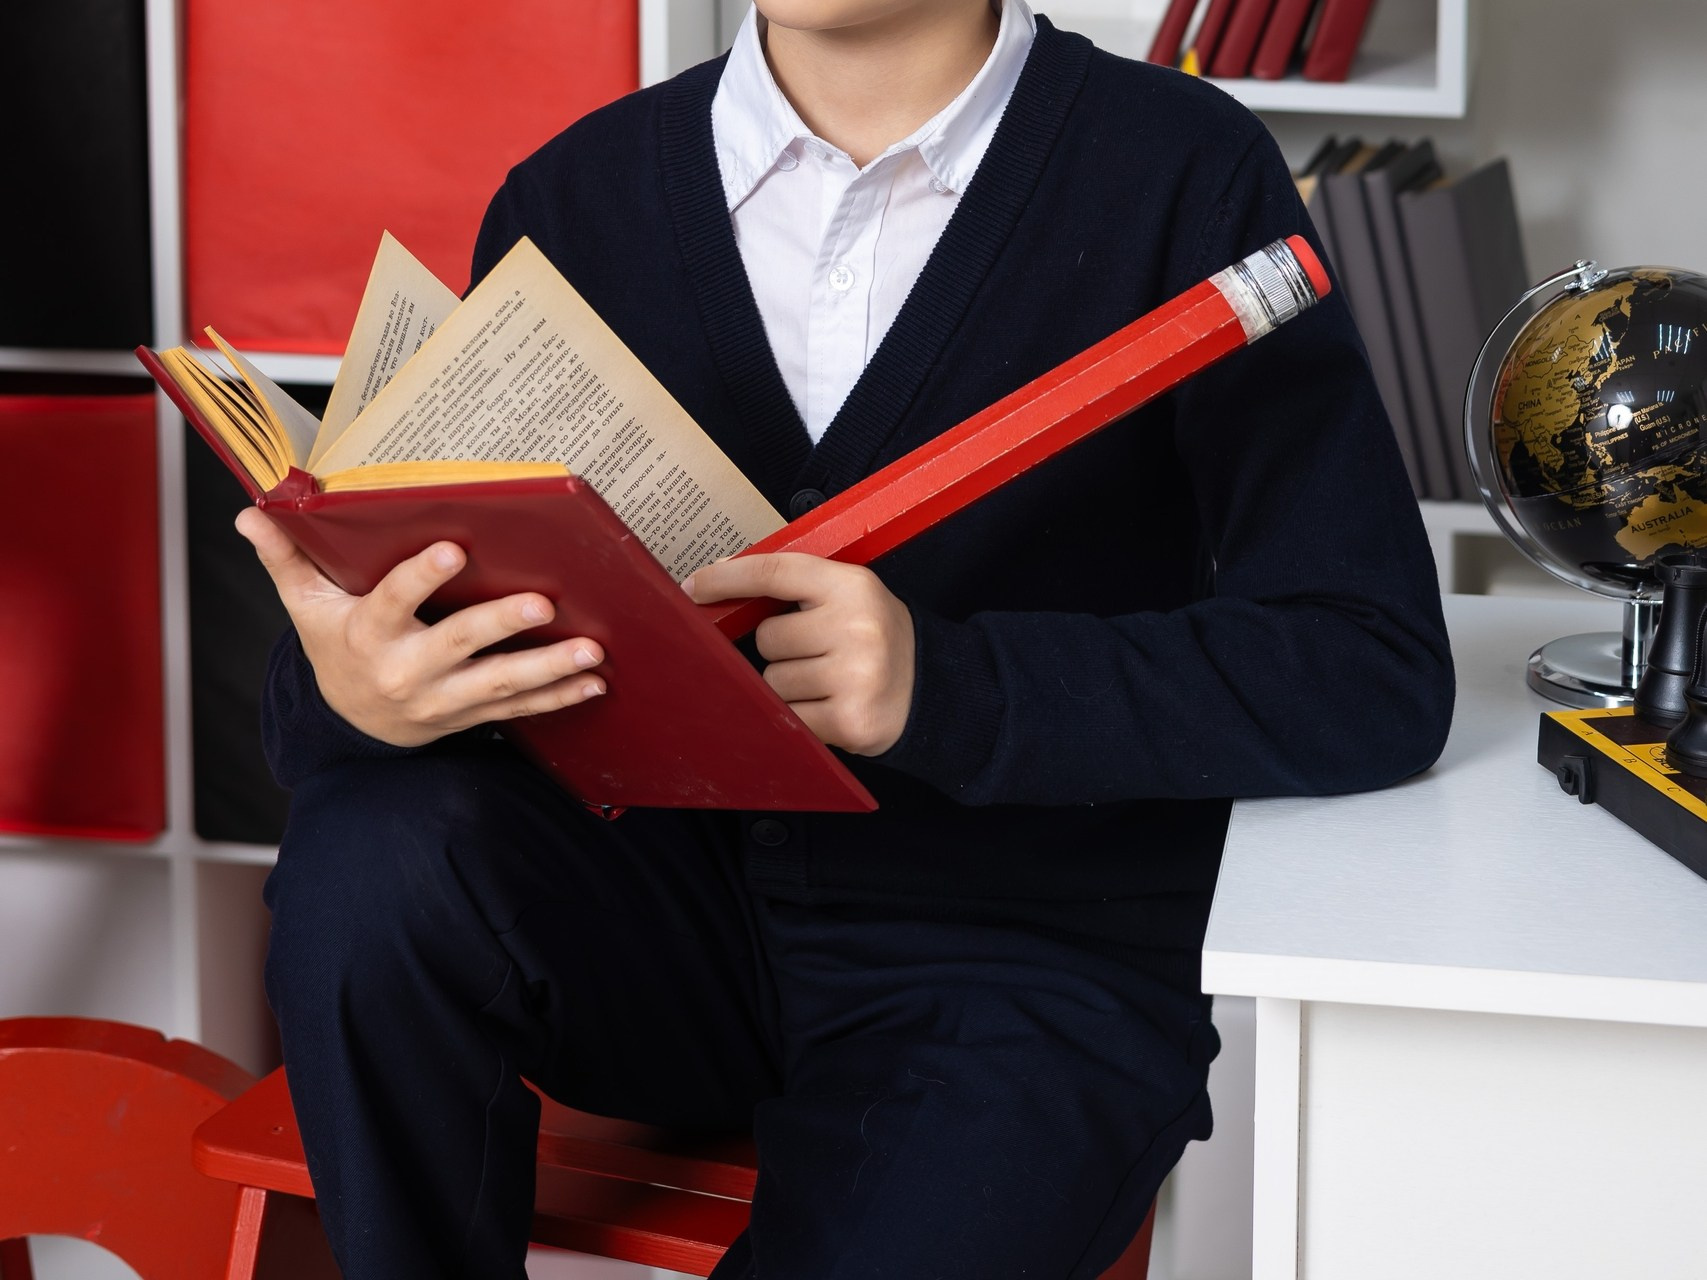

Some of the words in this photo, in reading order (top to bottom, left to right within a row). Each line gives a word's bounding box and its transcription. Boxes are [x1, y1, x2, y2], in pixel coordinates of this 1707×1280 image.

[360, 348, 382, 401] безошибочно
[379, 321, 391, 348] угадав
[388, 309, 395, 320] во
[379, 337, 395, 373] жаждали
[392, 296, 407, 336] немедлен-
[389, 356, 398, 370] что
[395, 317, 411, 355] пришлось
[407, 301, 415, 315] им
[419, 316, 428, 337] кост-
[368, 409, 413, 457] впечатление,
[414, 391, 427, 404] что
[429, 377, 440, 388] он
[441, 364, 451, 376] не
[461, 320, 492, 354] колонию
[494, 299, 513, 317] ехал,
[375, 421, 414, 463] порадовать
[416, 392, 439, 417] своим
[441, 338, 488, 389] присутствием
[491, 297, 526, 335] какое-ни-
[422, 437, 440, 454] ваш,
[440, 402, 469, 433] господа
[470, 367, 502, 401] хорошие.
[503, 350, 516, 364] Ну
[517, 334, 530, 349] вот
[532, 317, 547, 333] вам
[513, 397, 541, 424] Может,
[541, 382, 553, 394] ты
[554, 366, 566, 380] все
[567, 353, 579, 365] же
[1614, 355, 1635, 367] JAPAN
[406, 405, 440, 443] заведение
[441, 387, 456, 404] или
[457, 359, 485, 386] казино.
[422, 420, 441, 440] лица
[442, 367, 489, 418] встречающих.
[450, 421, 477, 452] парень!
[486, 388, 507, 411] бодро
[508, 351, 542, 387] отозвался
[541, 333, 558, 350] Бес-
[465, 416, 496, 450] колония
[496, 397, 513, 414] тебе
[515, 352, 553, 395] настроение
[555, 339, 566, 350] не
[471, 440, 490, 457] мне,
[489, 425, 501, 437] ты
[501, 407, 518, 424] туда
[525, 386, 536, 397] не
[537, 347, 571, 384] особенно-
[498, 438, 518, 458] угол,
[517, 411, 540, 436] своего
[540, 383, 568, 411] пидора,
[567, 361, 584, 381] жир-
[504, 446, 520, 462] тим
[521, 427, 537, 444] тебе
[538, 391, 570, 425] придется
[571, 368, 590, 390] подо-
[538, 434, 556, 453] пока
[565, 383, 605, 422] бродягами,
[556, 374, 598, 420] передразнил
[559, 434, 569, 444] со
[570, 413, 587, 432] всей
[587, 389, 610, 411] Сиби-
[1518, 398, 1541, 410] CHINA
[426, 442, 446, 461] яйте
[447, 398, 487, 440] наручники.
[561, 419, 597, 457] компания.
[596, 395, 616, 417] Возь-
[563, 439, 590, 466] ченьки
[591, 428, 601, 439] да
[601, 402, 624, 426] суньте
[578, 458, 598, 480] вших
[598, 444, 610, 458] его
[611, 416, 635, 443] офице-
[594, 424, 643, 475] поморщились,
[1640, 422, 1655, 431] Guam
[1656, 416, 1671, 427] (U.S.)
[594, 478, 604, 488] не
[605, 456, 623, 477] наше
[625, 429, 647, 455] сопро-
[618, 437, 655, 474] Беспалый.
[622, 463, 654, 499] попросил
[655, 450, 666, 462] за-
[655, 464, 679, 488] Беспа-
[641, 511, 661, 533] назад
[661, 496, 675, 510] три
[676, 477, 693, 495] вора
[647, 498, 661, 513] они
[662, 469, 687, 496] вышли
[659, 518, 679, 540] велел
[680, 491, 705, 517] связать
[661, 483, 699, 524] неласковое
[1632, 506, 1693, 533] AUSTRALIA
[658, 543, 669, 555] он
[679, 497, 710, 532] «локалке»
[673, 539, 696, 565] обязан
[696, 523, 711, 539] был
[711, 510, 722, 523] от-
[675, 562, 688, 576] кто
[689, 538, 708, 560] стоит
[709, 516, 730, 538] перед
[715, 546, 725, 558] он
[726, 531, 741, 546] сам.
[719, 524, 734, 540] тон-
[1543, 518, 1581, 531] OCEAN
